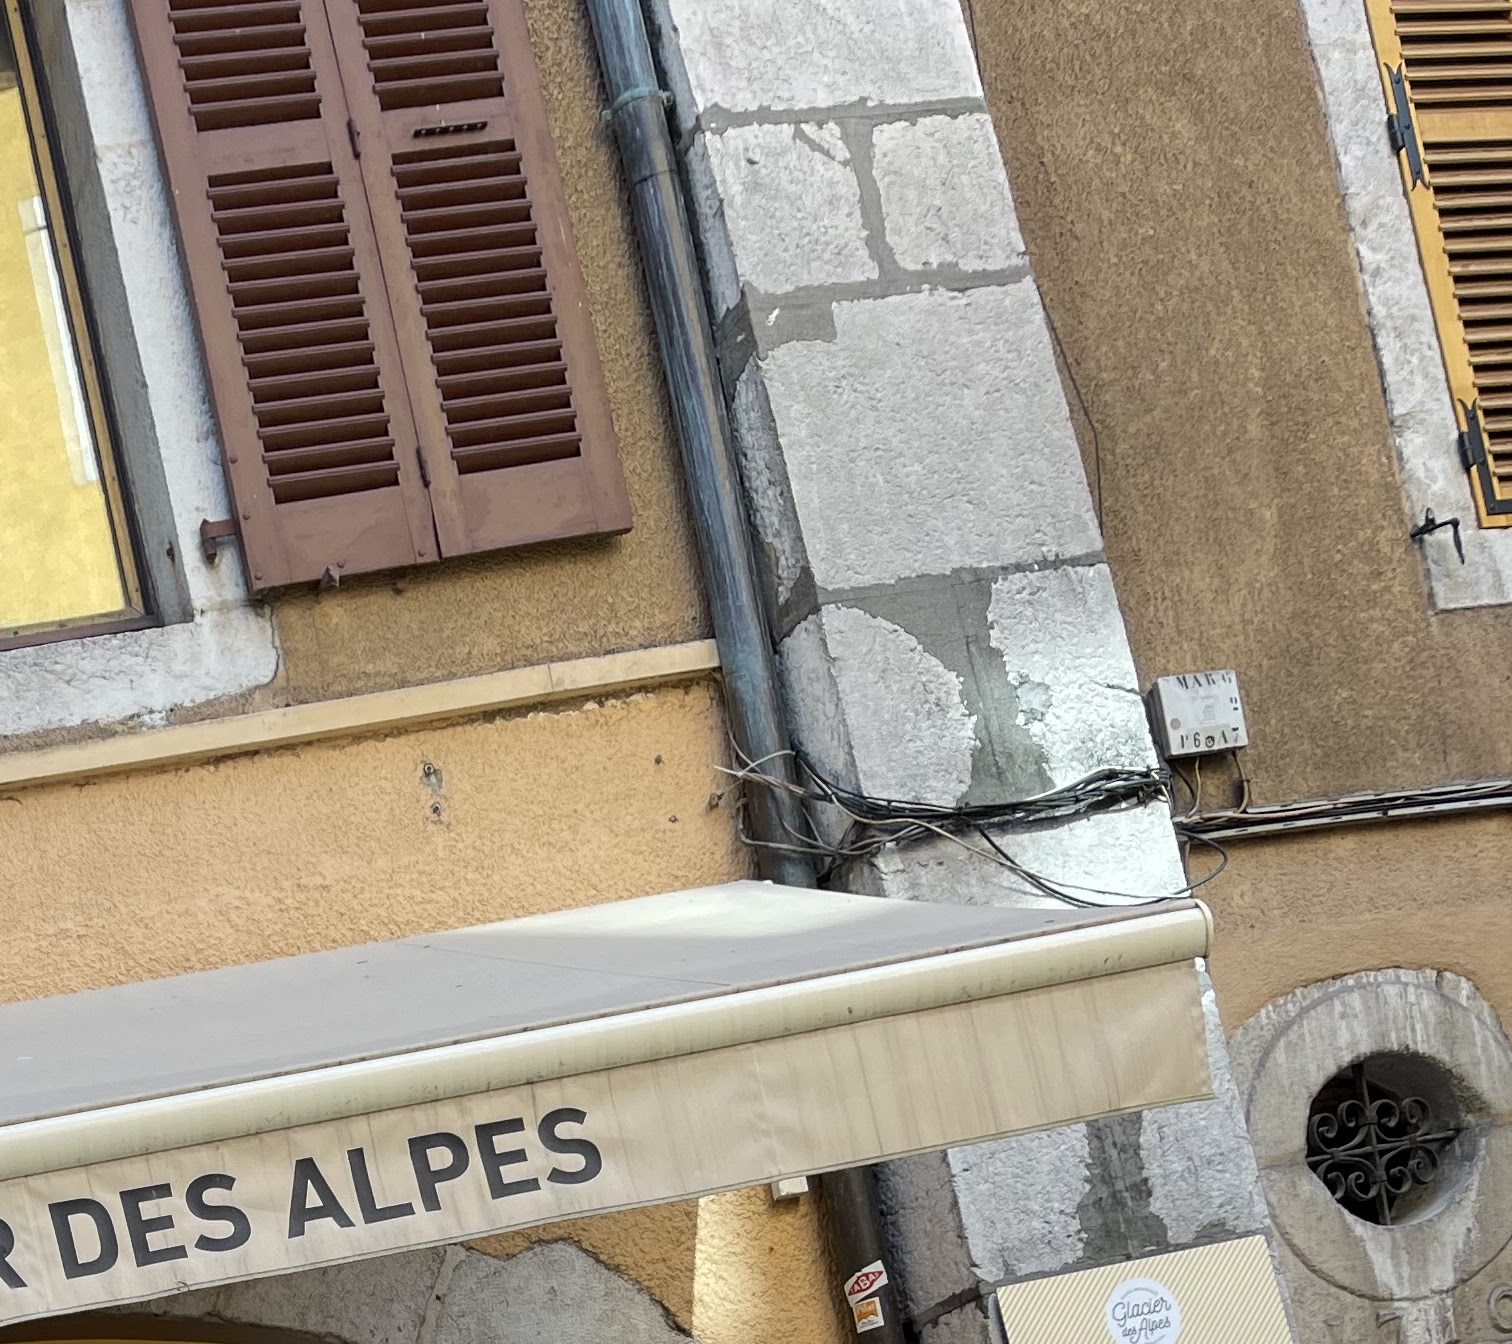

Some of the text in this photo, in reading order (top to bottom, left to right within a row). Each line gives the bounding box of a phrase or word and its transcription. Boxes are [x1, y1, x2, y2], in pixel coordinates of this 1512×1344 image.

[48, 1171, 253, 1281] DES
[287, 1106, 604, 1239] ALPES
[1112, 1296, 1172, 1328] Glacier
[1121, 1315, 1172, 1344] des Alpes
